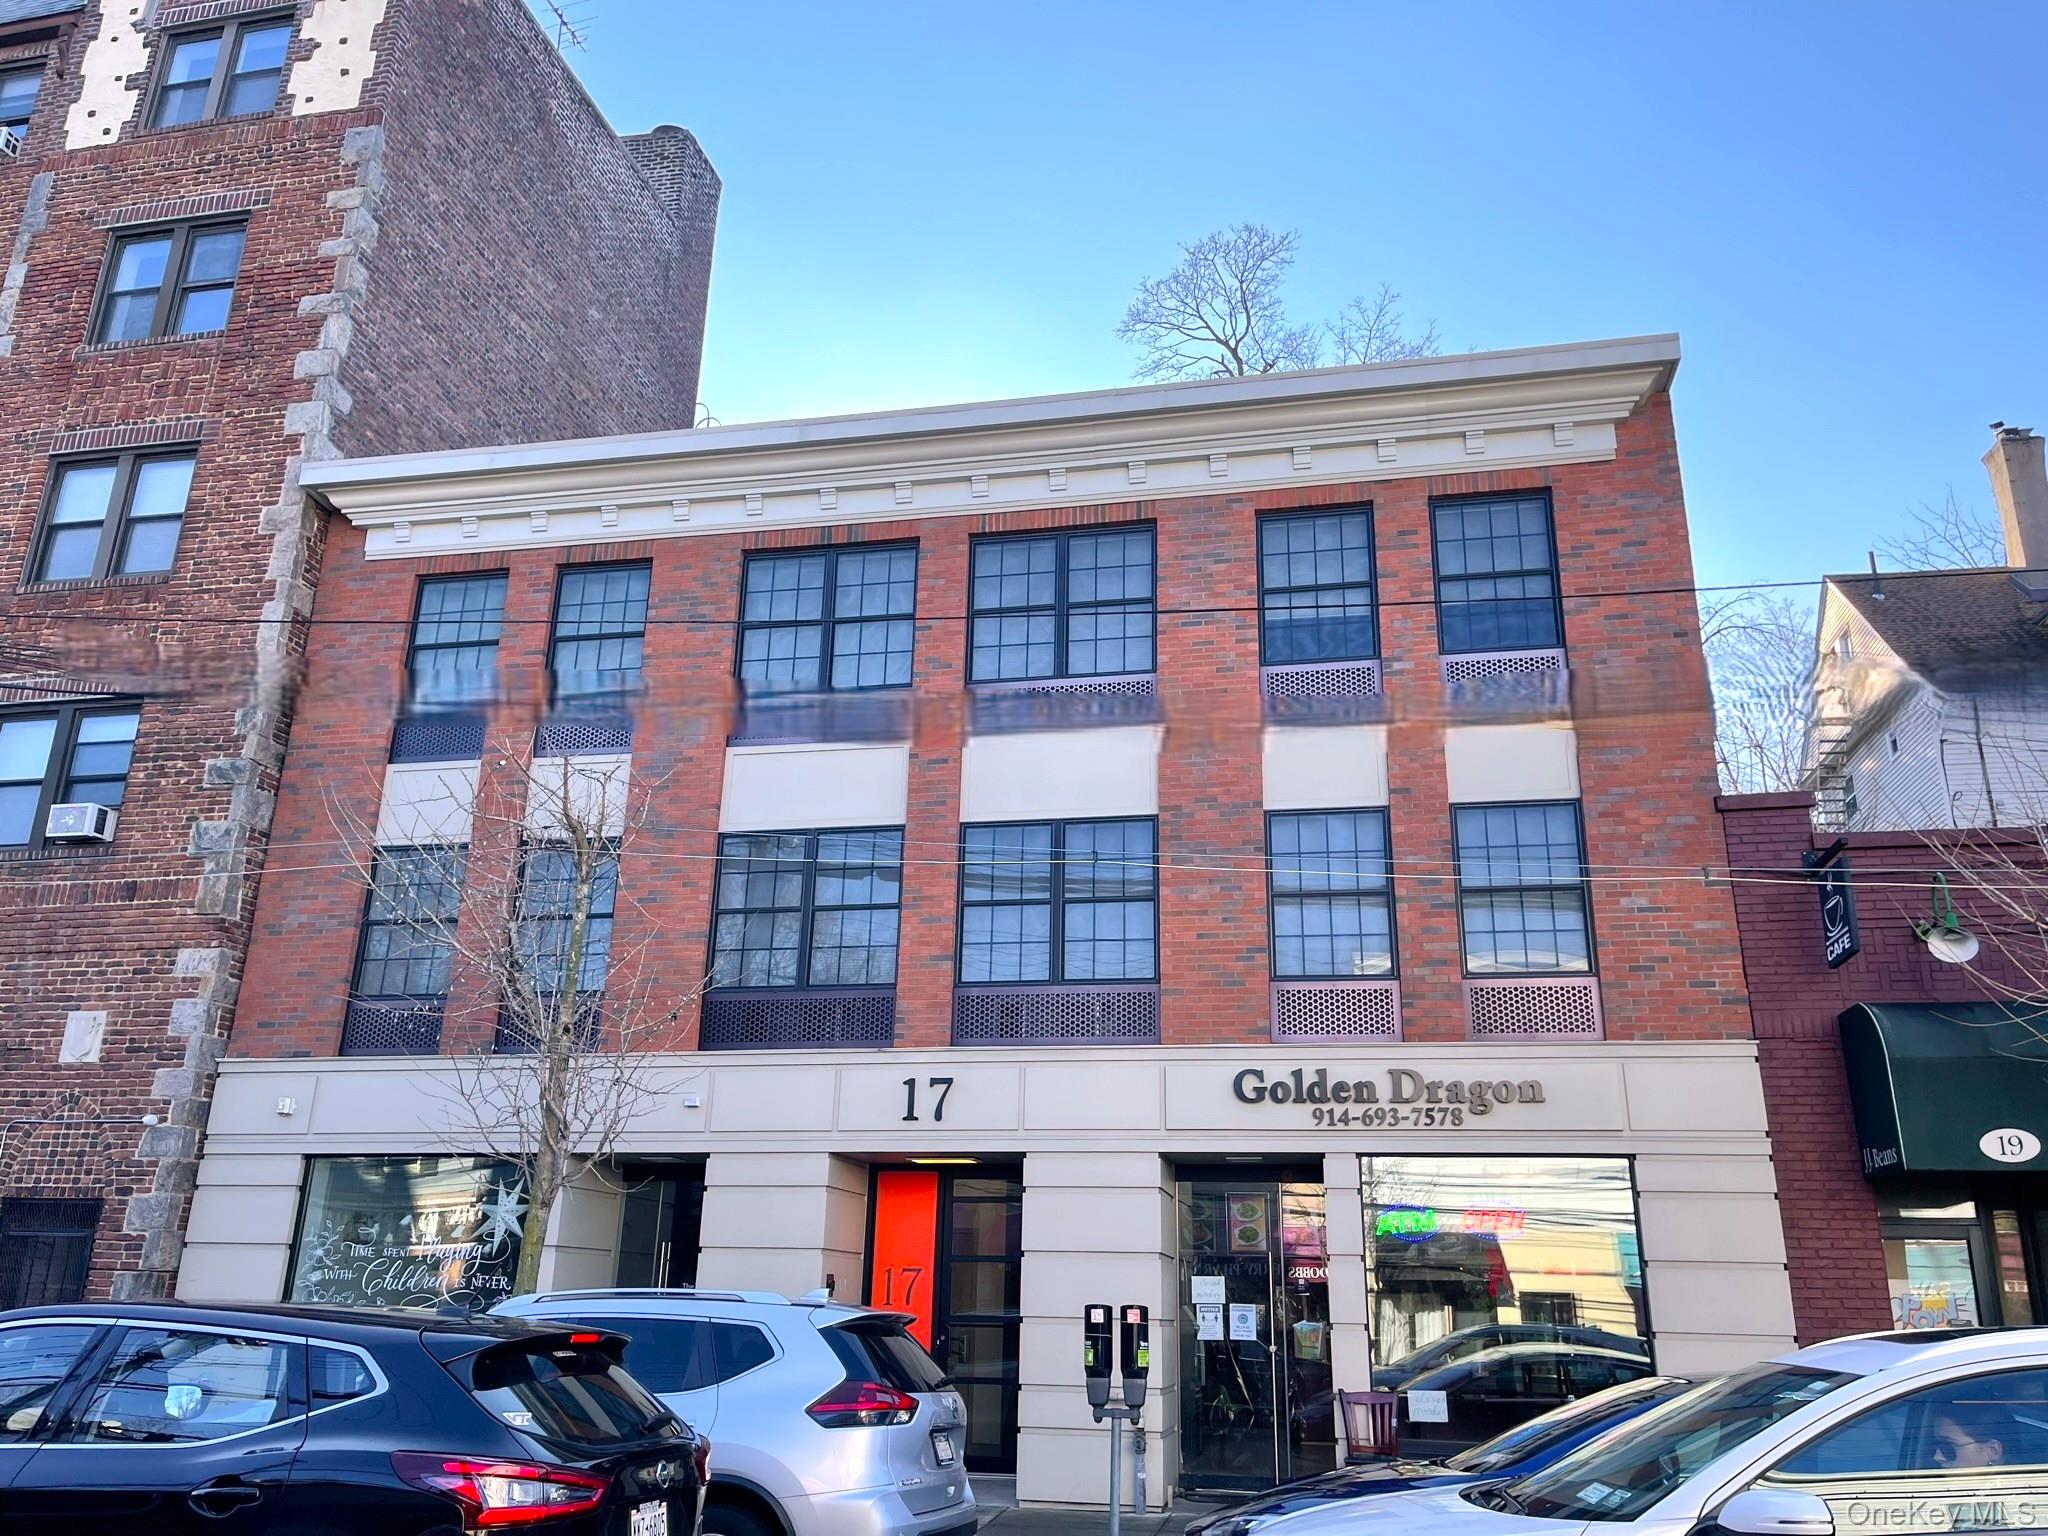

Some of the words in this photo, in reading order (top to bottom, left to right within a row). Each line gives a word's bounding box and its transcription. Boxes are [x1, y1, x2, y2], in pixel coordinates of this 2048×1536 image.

[1827, 933, 1851, 961] CAFE
[902, 1077, 954, 1122] 17
[1233, 1068, 1379, 1104] Golden
[1387, 1068, 1545, 1115] Dragon
[1312, 1106, 1464, 1127] 914-693-7578
[1872, 1147, 1898, 1168] Beans
[1998, 1135, 2024, 1156] 19
[344, 1242, 376, 1257] TIME
[382, 1247, 411, 1257] SPENT
[416, 1232, 485, 1276] Playing
[323, 1266, 355, 1280] WITH
[357, 1258, 450, 1296] Children
[882, 1267, 922, 1306] 17
